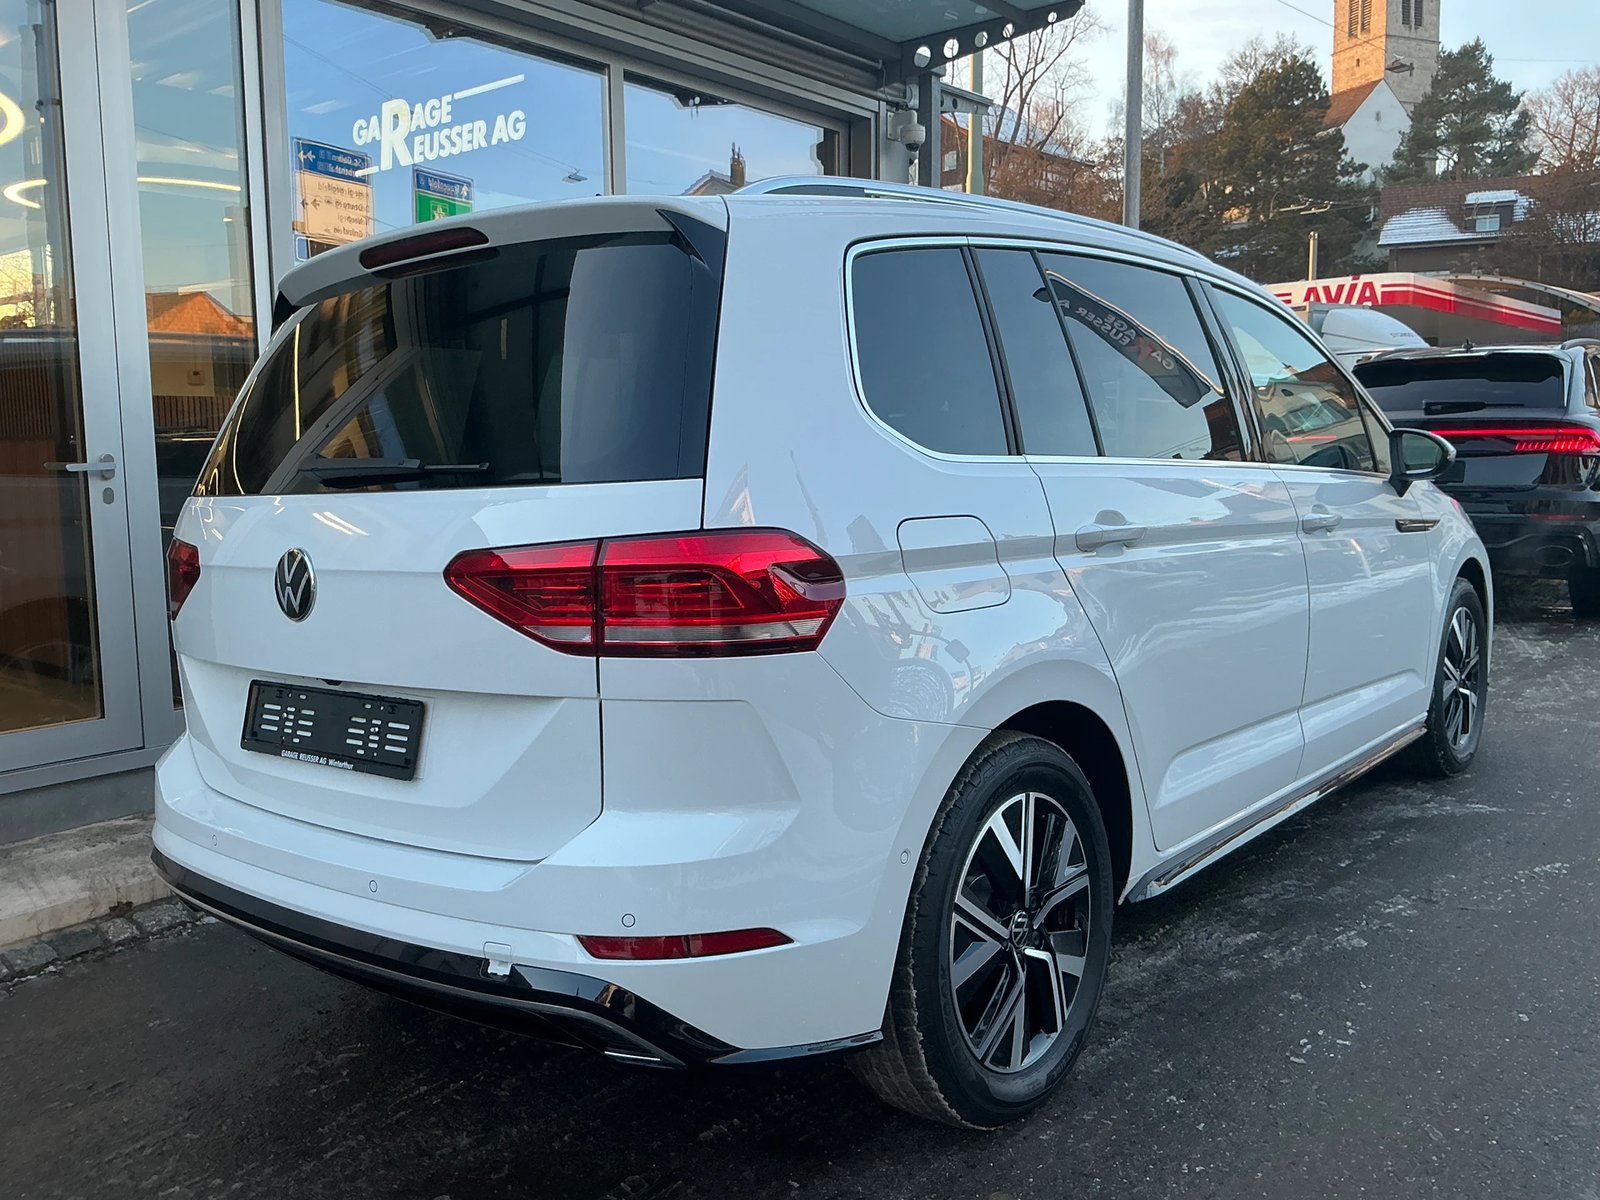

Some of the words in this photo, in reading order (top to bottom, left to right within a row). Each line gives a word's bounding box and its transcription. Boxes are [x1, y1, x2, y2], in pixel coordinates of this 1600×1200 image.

[491, 109, 527, 146] AG
[1303, 276, 1379, 305] AVIA
[281, 749, 299, 760] GARAGE
[299, 752, 320, 763] REUSSER
[319, 756, 327, 765] AG
[328, 758, 354, 770] Winterthur
